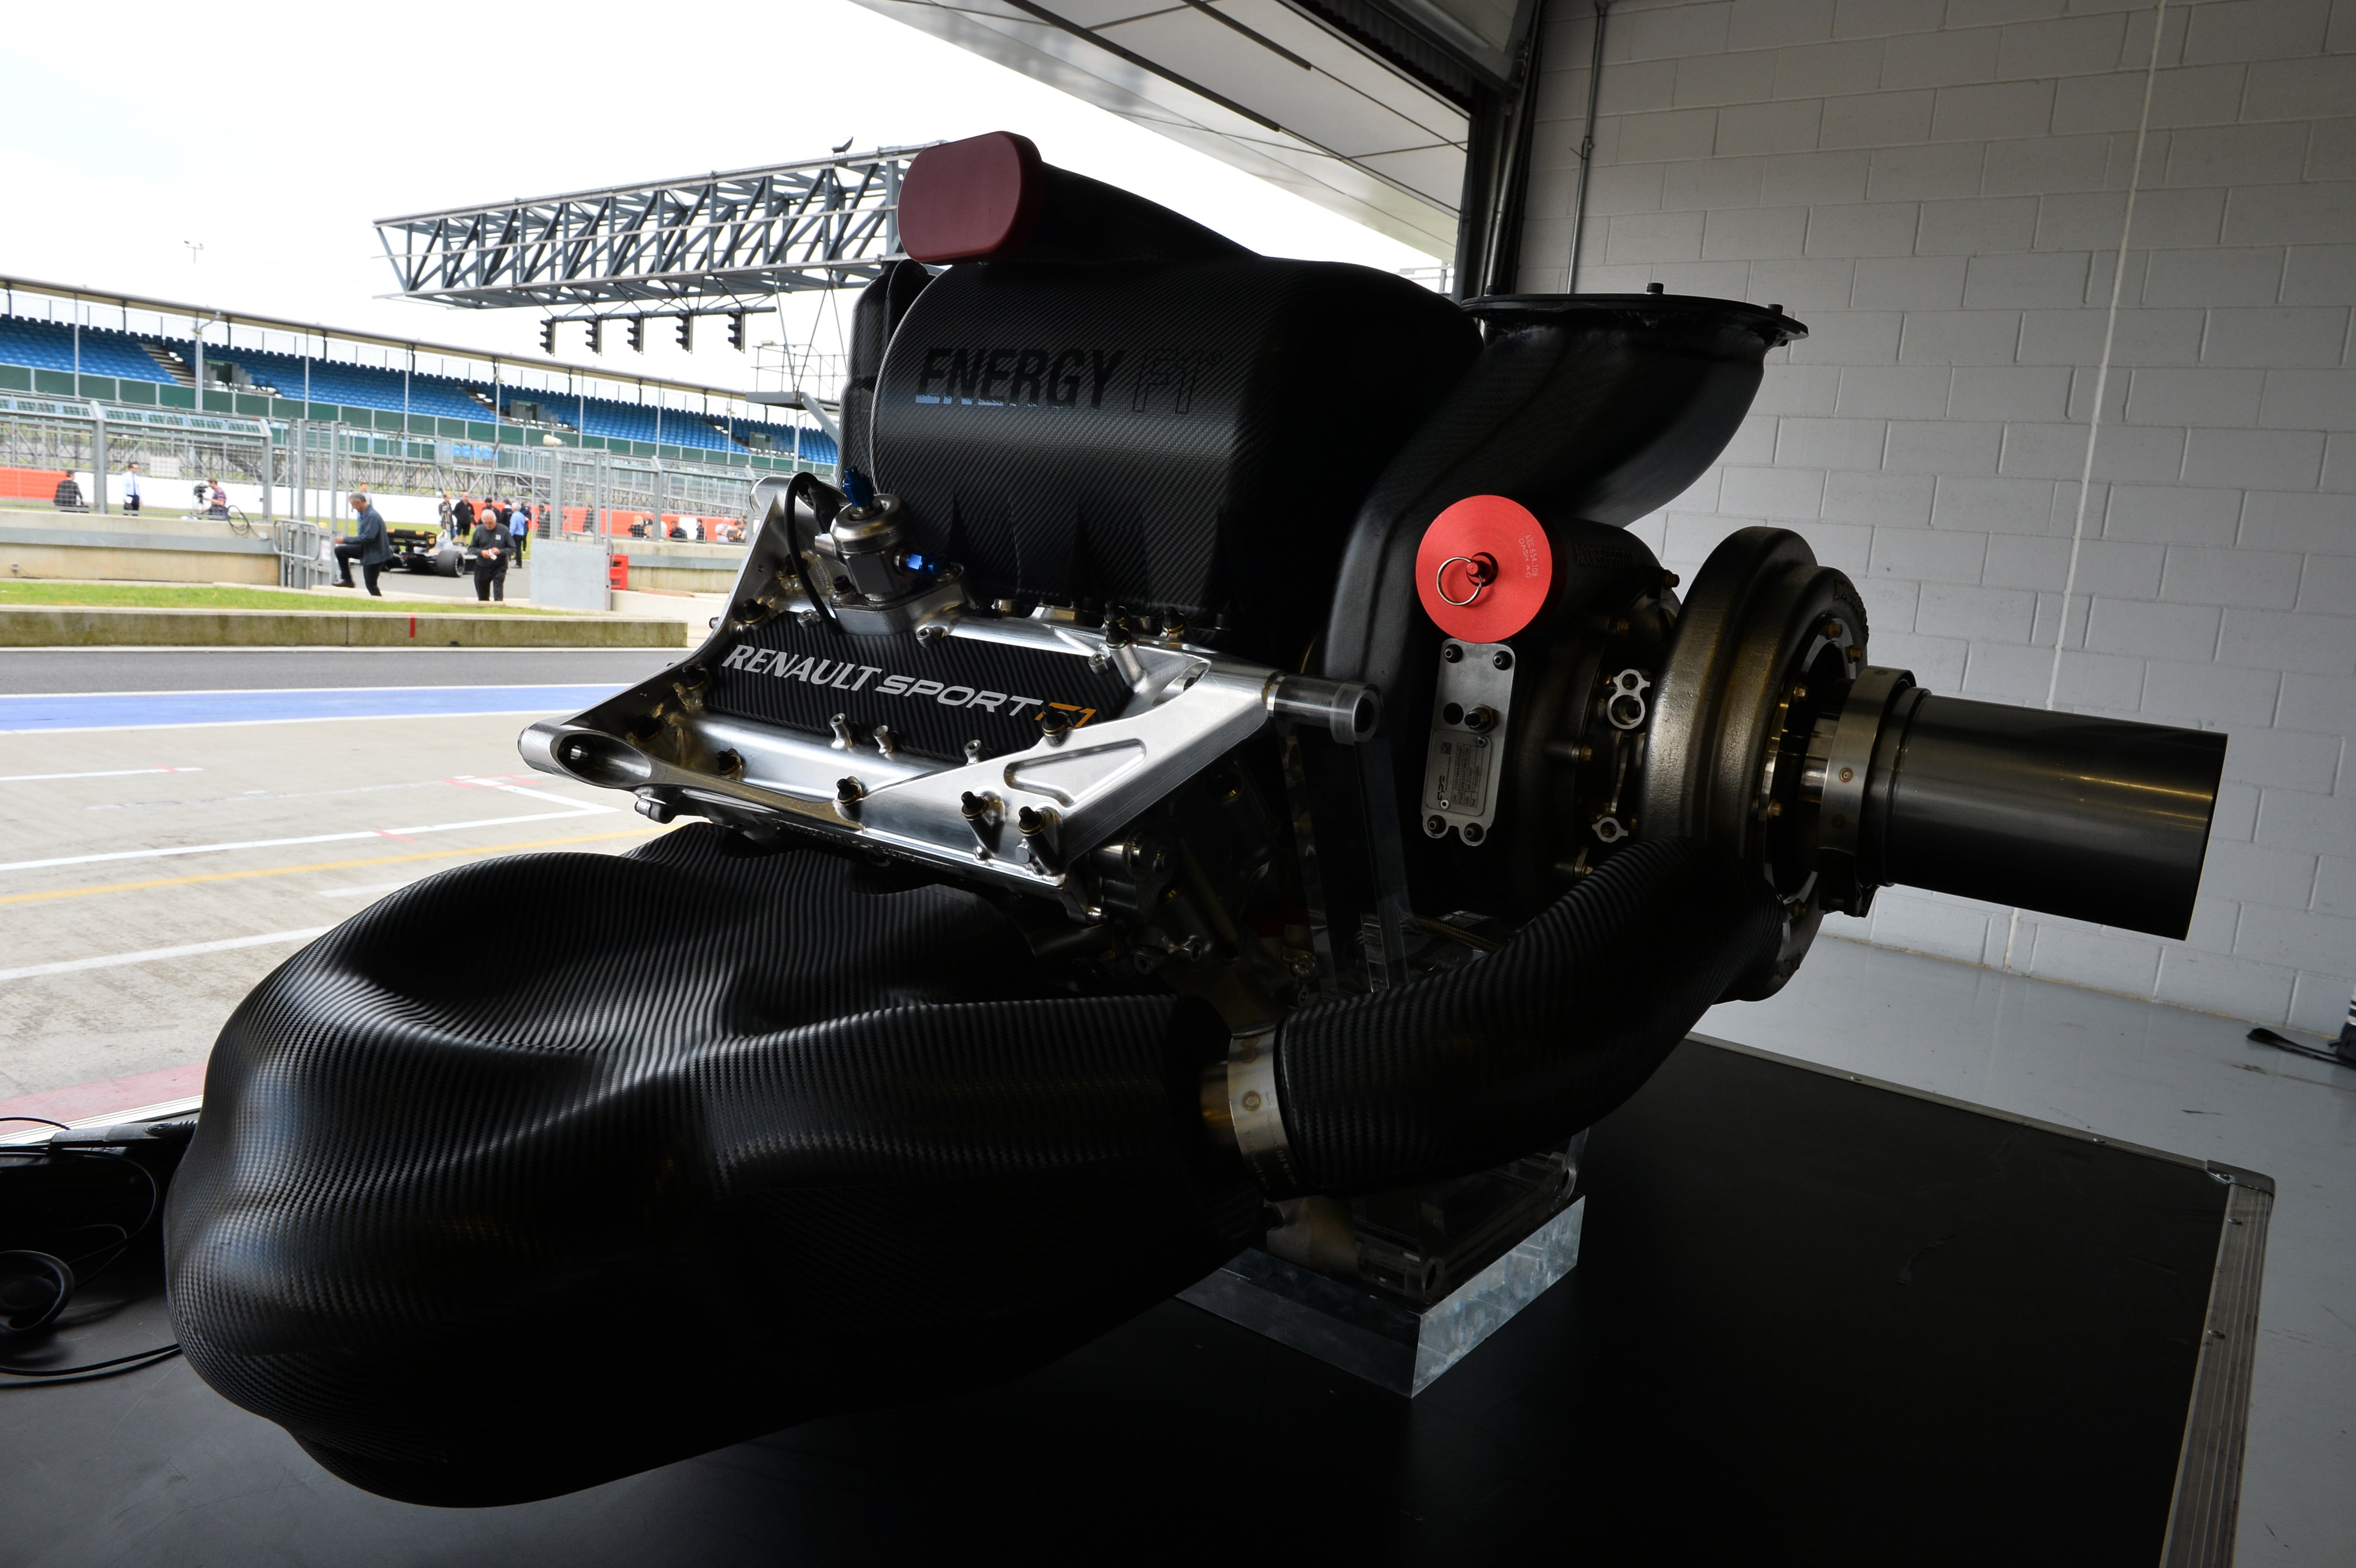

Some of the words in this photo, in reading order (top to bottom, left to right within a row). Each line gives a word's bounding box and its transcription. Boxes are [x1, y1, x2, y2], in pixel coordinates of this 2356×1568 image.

[915, 348, 1125, 410] ENERGY
[1518, 538, 1529, 562] DASH
[1526, 565, 1531, 578] 40
[721, 644, 882, 691] RENAULT
[875, 675, 1043, 716] SPORT
